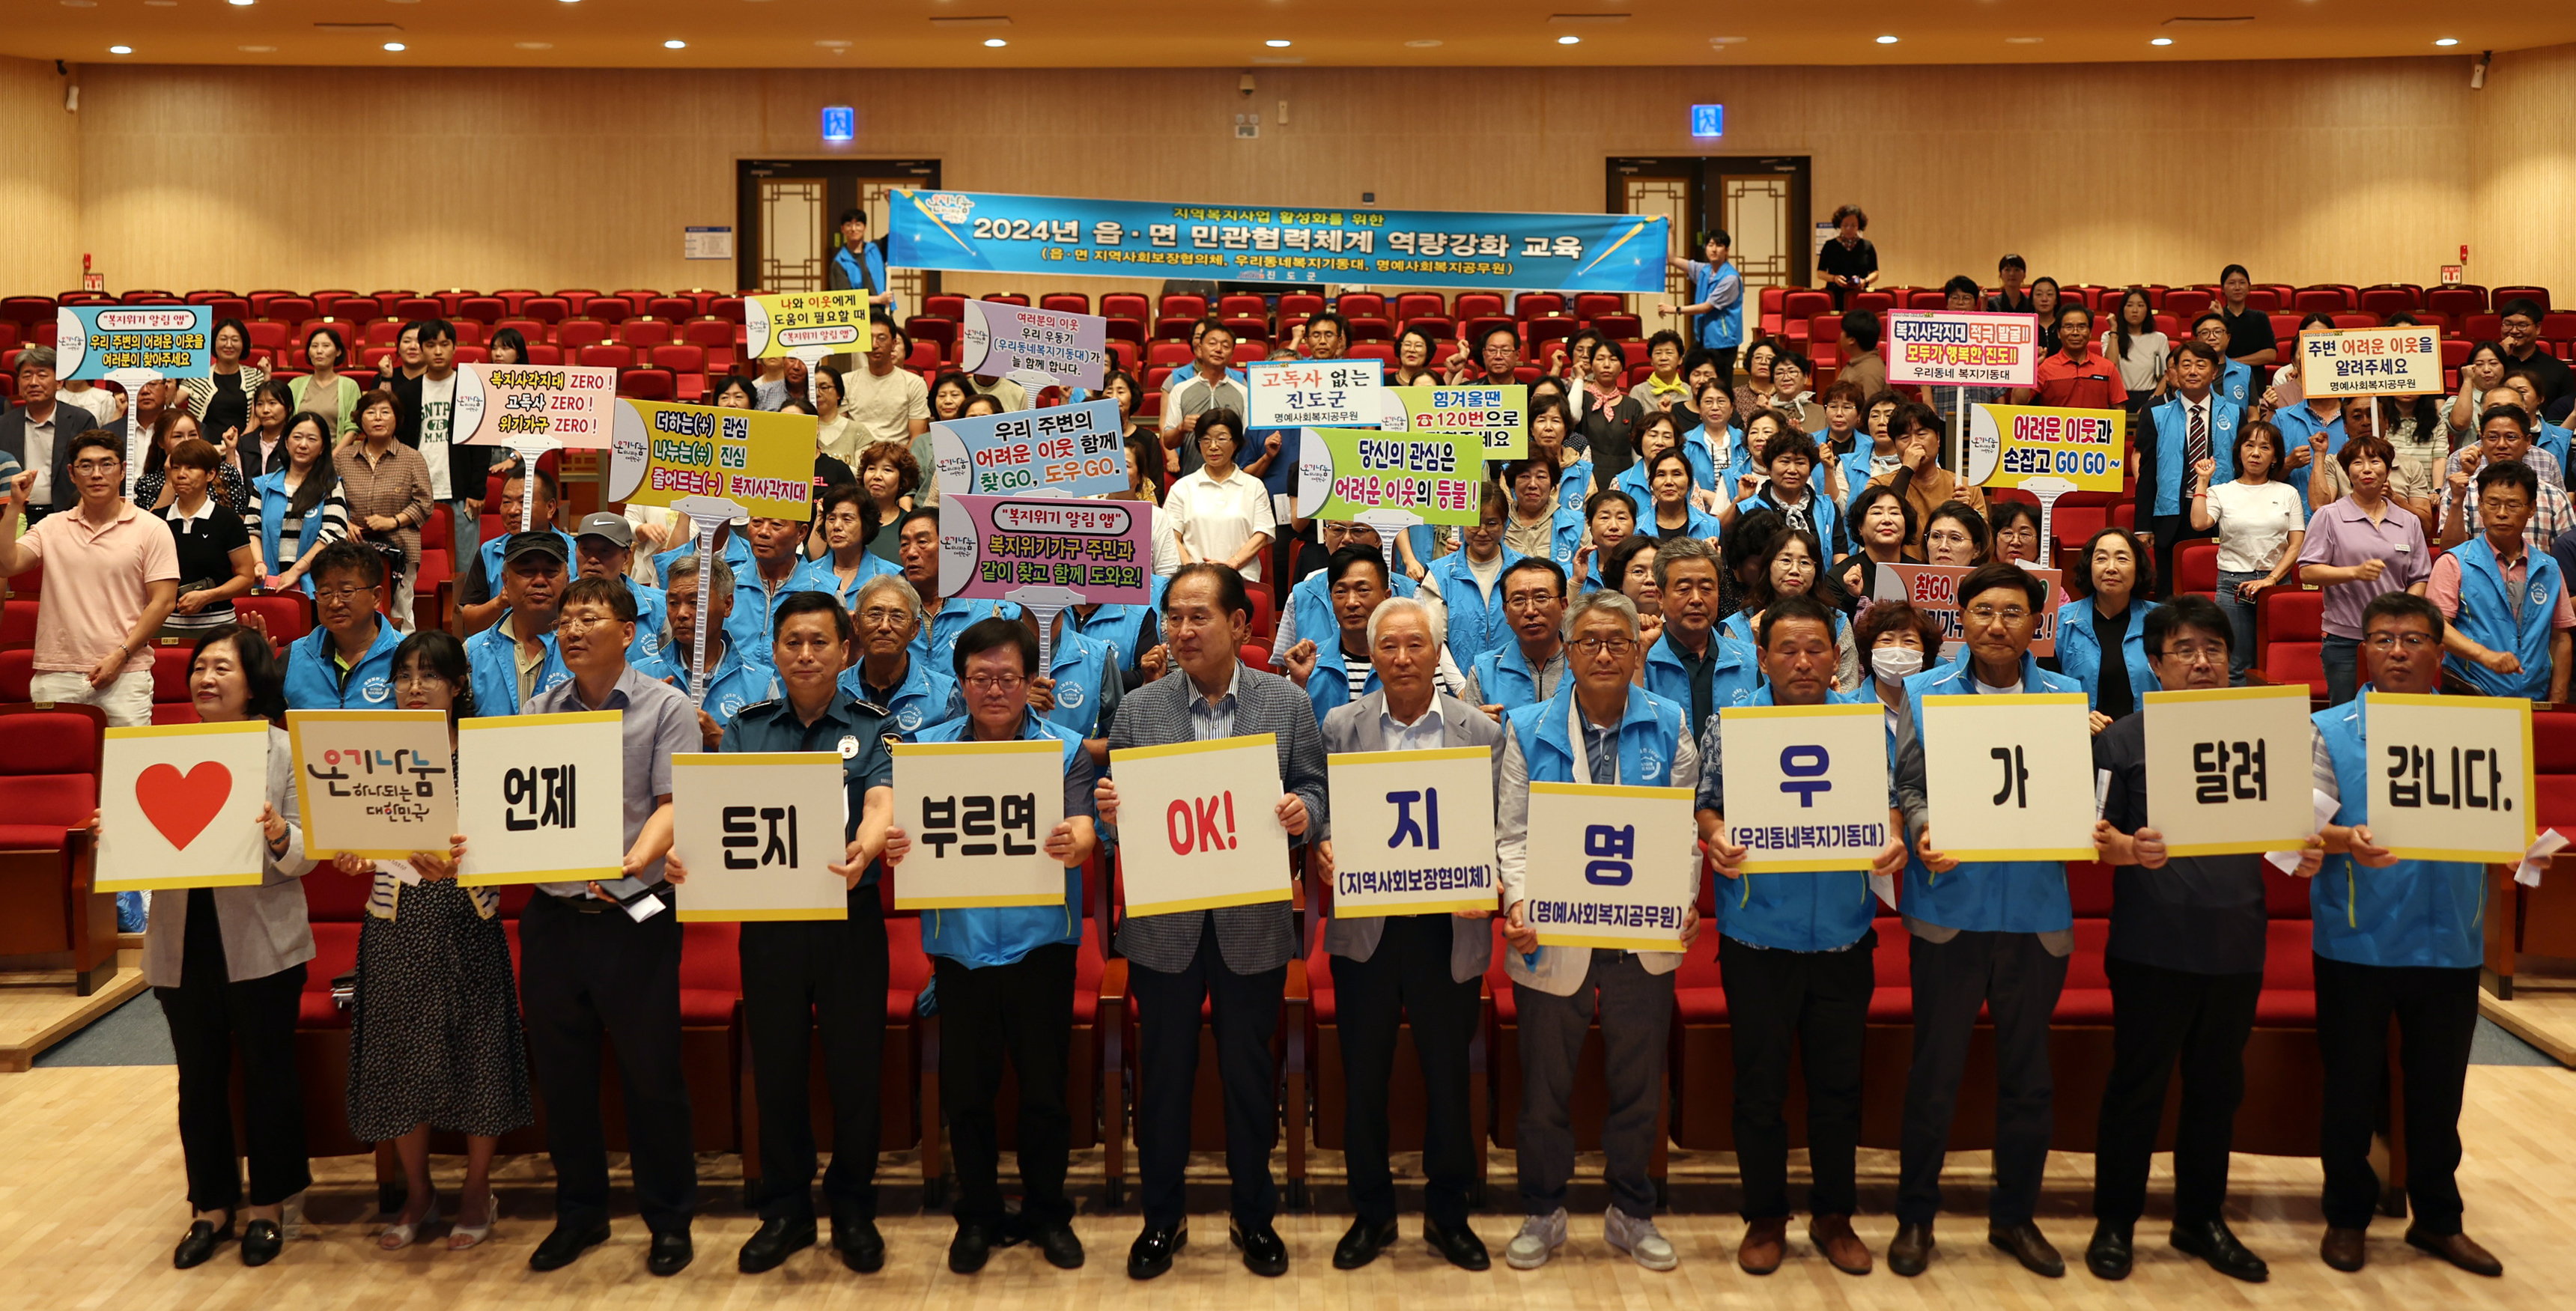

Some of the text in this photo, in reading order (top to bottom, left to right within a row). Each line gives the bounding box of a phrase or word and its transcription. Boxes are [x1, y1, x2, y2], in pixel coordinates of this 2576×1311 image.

[1173, 207, 1385, 227] 지역복지사업 활성화를 위한
[973, 217, 1080, 243] 2024년
[1191, 225, 1374, 254] 민관협력체계
[1388, 231, 1510, 258] 역량강화
[1521, 235, 1583, 260] 교육
[1376, 259, 1513, 276] 명예사회복지공무원)
[781, 294, 856, 310] 나와 이웃에게
[103, 314, 189, 327] "복지위기 알림 앱"
[774, 309, 866, 326] 도움이 필요할 때
[1017, 312, 1079, 332] 여러분의 이웃
[90, 335, 109, 350] 우리
[112, 334, 141, 350] 주변의
[144, 334, 173, 350] 어려운
[175, 333, 205, 349] 이웃을
[783, 332, 818, 343] "복지위기
[820, 330, 837, 341] 알림
[1021, 328, 1073, 344] 우리 우동기
[1895, 321, 2030, 344] 복지사각지대 적극 발굴!!
[994, 338, 1100, 363] (우리동네복지기동대)가
[1906, 343, 2018, 365] 모두가 행복한 진도!!
[2309, 336, 2432, 357] 주변 어려운 이웃을
[102, 352, 191, 368] 여러분이 찾아주세요
[1012, 356, 1081, 376] 늘 함께 합니다.
[2336, 358, 2408, 376] 알려주세요
[490, 371, 565, 390] 복지사각지대
[570, 374, 604, 389] ZERO
[1262, 368, 1370, 389] 고독사 없는
[1913, 367, 2010, 380] 우리동네 복지기동대
[2330, 379, 2416, 391] 명예사회복지공무원
[505, 394, 545, 411] 고독사
[550, 396, 584, 410] ZERO
[1287, 391, 1346, 409] 진도군
[1433, 391, 1501, 408] 힘겨울땐
[432, 419, 444, 431] 76
[499, 414, 549, 434] 위기가구
[555, 418, 589, 433] ZERO
[655, 411, 748, 439] 더하는(+) 관심
[994, 410, 1093, 442] 우리 주변의
[1275, 411, 1358, 423] 명예사회복지공무원
[1437, 411, 1519, 427] 120번으로
[2014, 416, 2112, 444] 어려운 이웃과
[613, 440, 647, 457] 온기나눔
[976, 431, 1118, 467] 어려운 이웃 함께
[1971, 437, 1998, 448] 온기나눔
[654, 439, 745, 468] 나누는(÷) 진심
[1359, 439, 1455, 472] 당신의 관심은
[2004, 447, 2051, 473] 손잡고
[2056, 451, 2078, 474] GO
[2083, 451, 2105, 475] GO
[937, 457, 968, 472] 온기나눔
[1300, 464, 1331, 476] 온기나눔
[651, 466, 806, 502] 줄어드는(-) 복지사각지대
[1335, 475, 1381, 505] 어려운
[1386, 477, 1431, 507] 이웃의
[1436, 480, 1466, 509] 등불
[1002, 508, 1121, 529] "복지위기 알림 앱"
[941, 536, 976, 550] 온기나눔
[988, 535, 1135, 561] 복지위기가구 주민과
[981, 561, 1143, 587] 같이 찾고 함께 도와요!
[307, 749, 446, 797] 온기나눔
[1779, 744, 1832, 808] 우
[1990, 744, 2029, 809] 가
[2193, 737, 2268, 805] 달려
[2387, 745, 2514, 812] 갑니다.
[353, 782, 413, 803] 하나되는
[503, 763, 577, 832] 언제
[366, 801, 429, 822] 대한민국
[1385, 786, 1440, 851] 지
[921, 792, 1036, 859] 부르면
[1166, 789, 1238, 857] OK!
[722, 804, 799, 870] 든지
[1731, 822, 1885, 850] (우리동네복지기동대)
[1585, 824, 1635, 886] 명
[1339, 863, 1491, 897] (지역사회보장협의체)
[1528, 900, 1683, 929] (명예사회복지공무원)
